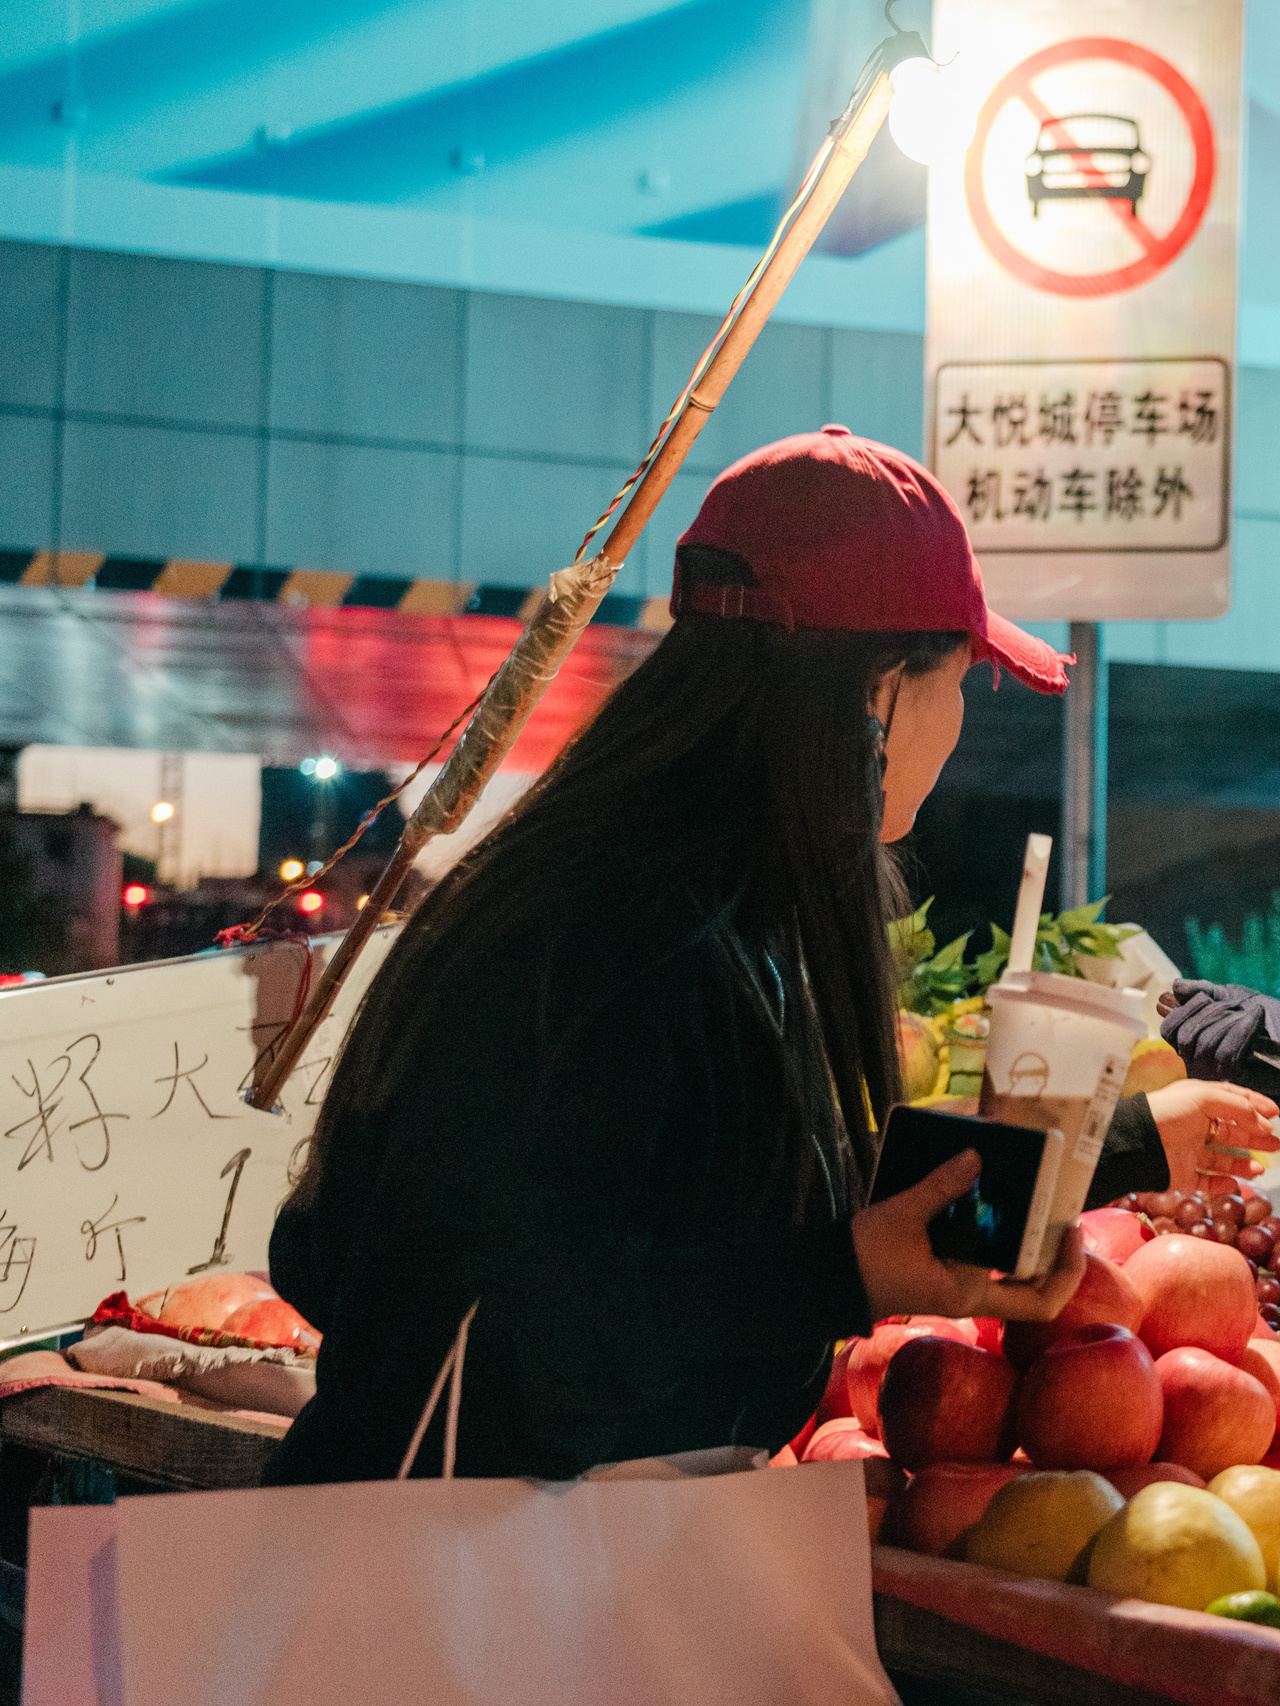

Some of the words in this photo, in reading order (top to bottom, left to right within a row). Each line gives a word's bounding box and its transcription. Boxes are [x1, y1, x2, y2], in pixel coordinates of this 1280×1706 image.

[944, 390, 1219, 446] 大悦城停车场
[966, 464, 1194, 522] 机动车除外
